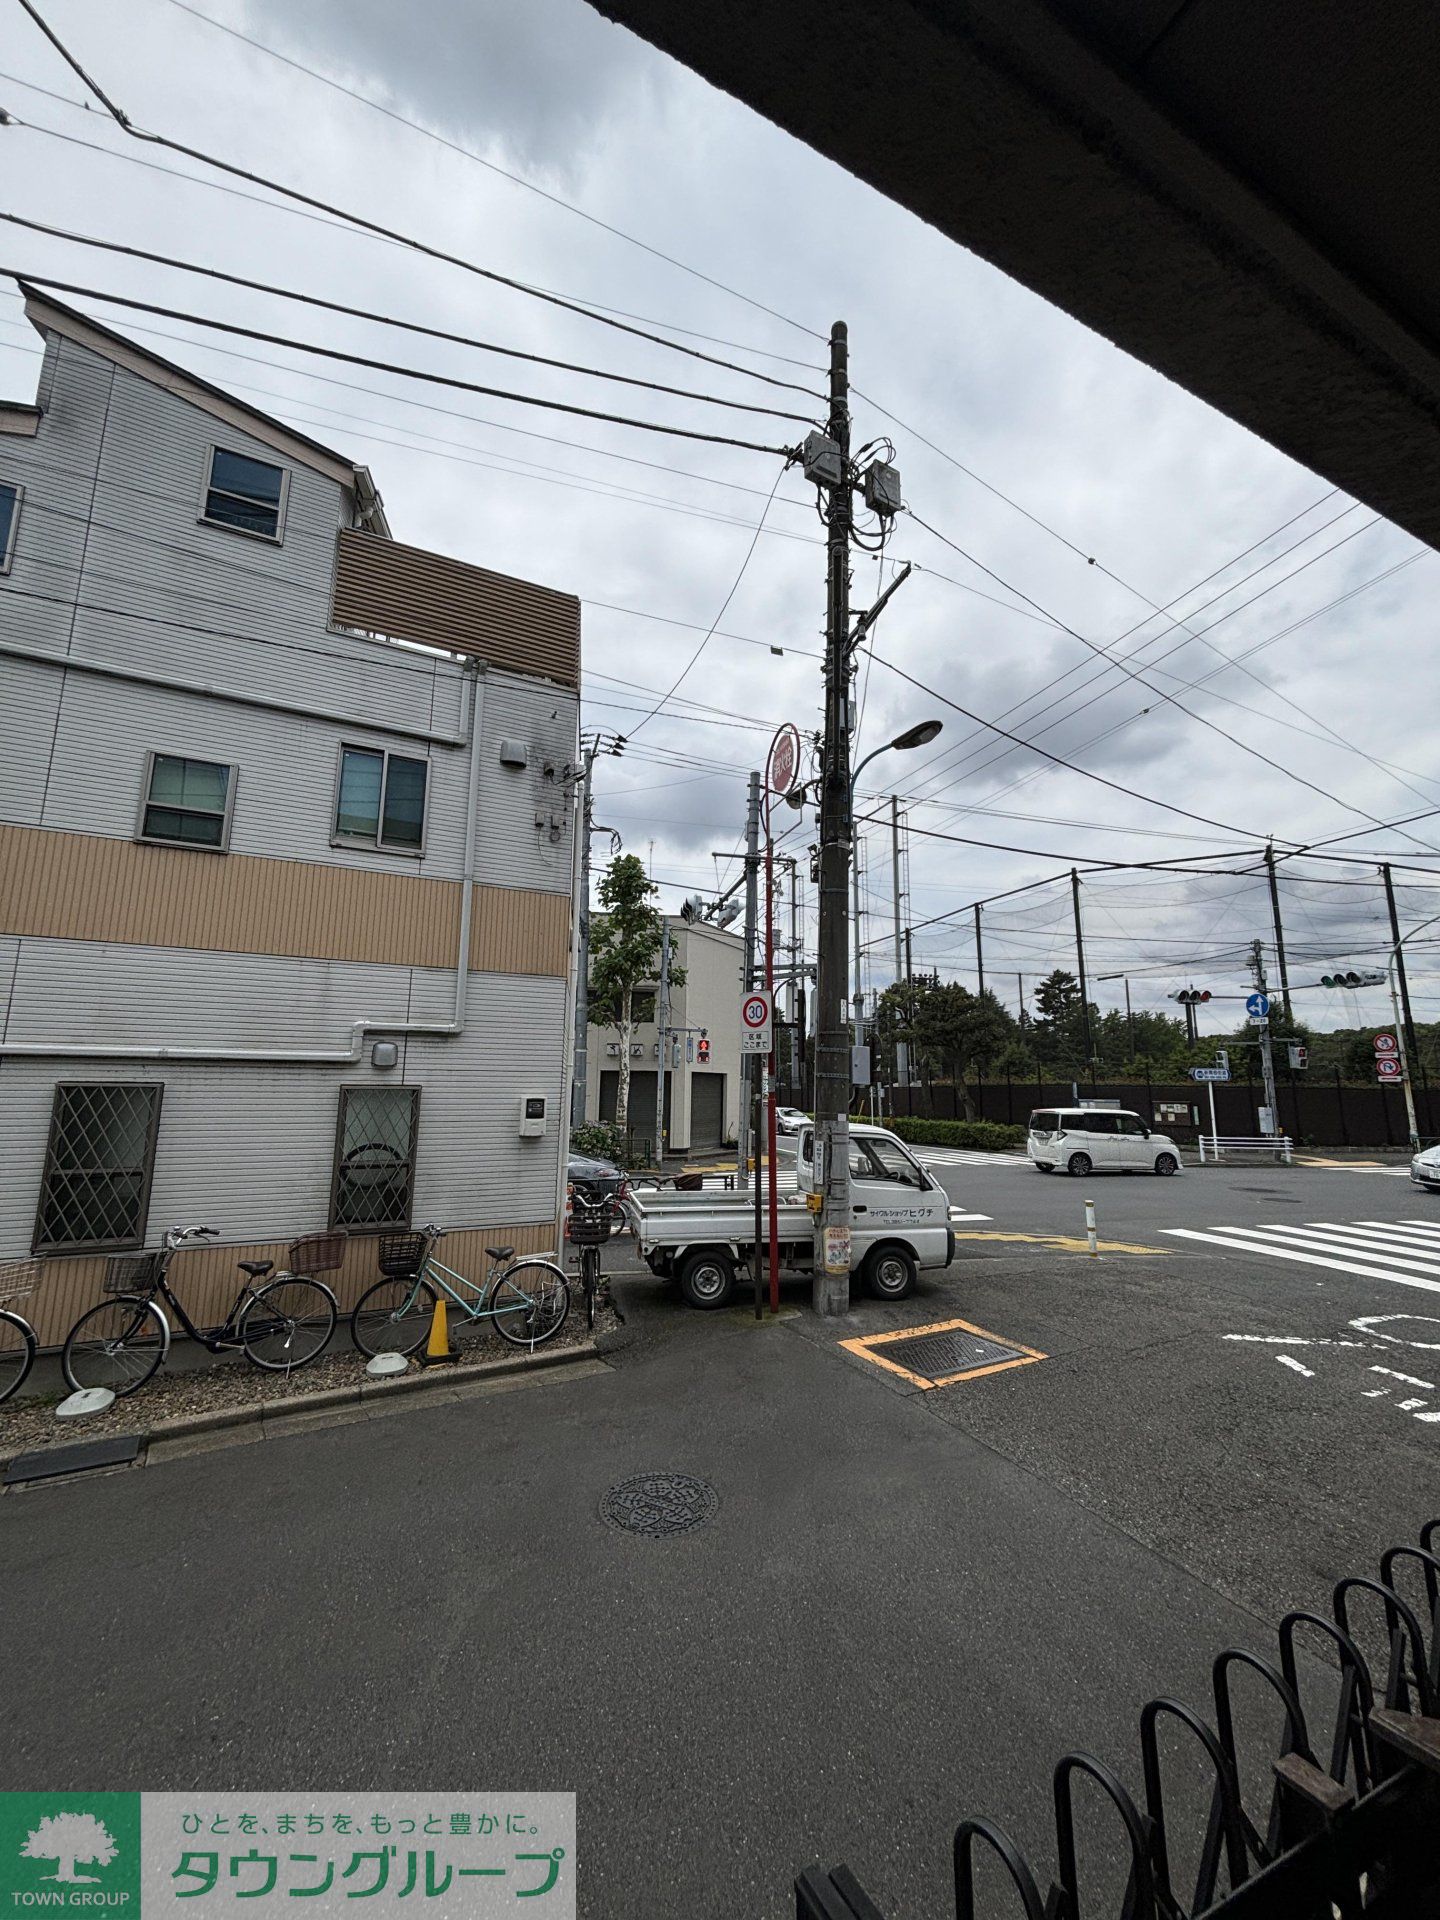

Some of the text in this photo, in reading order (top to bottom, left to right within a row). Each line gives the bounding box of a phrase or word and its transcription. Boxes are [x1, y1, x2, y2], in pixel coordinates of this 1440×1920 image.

[748, 1005, 763, 1019] 30
[744, 1041, 768, 1049] ここまで
